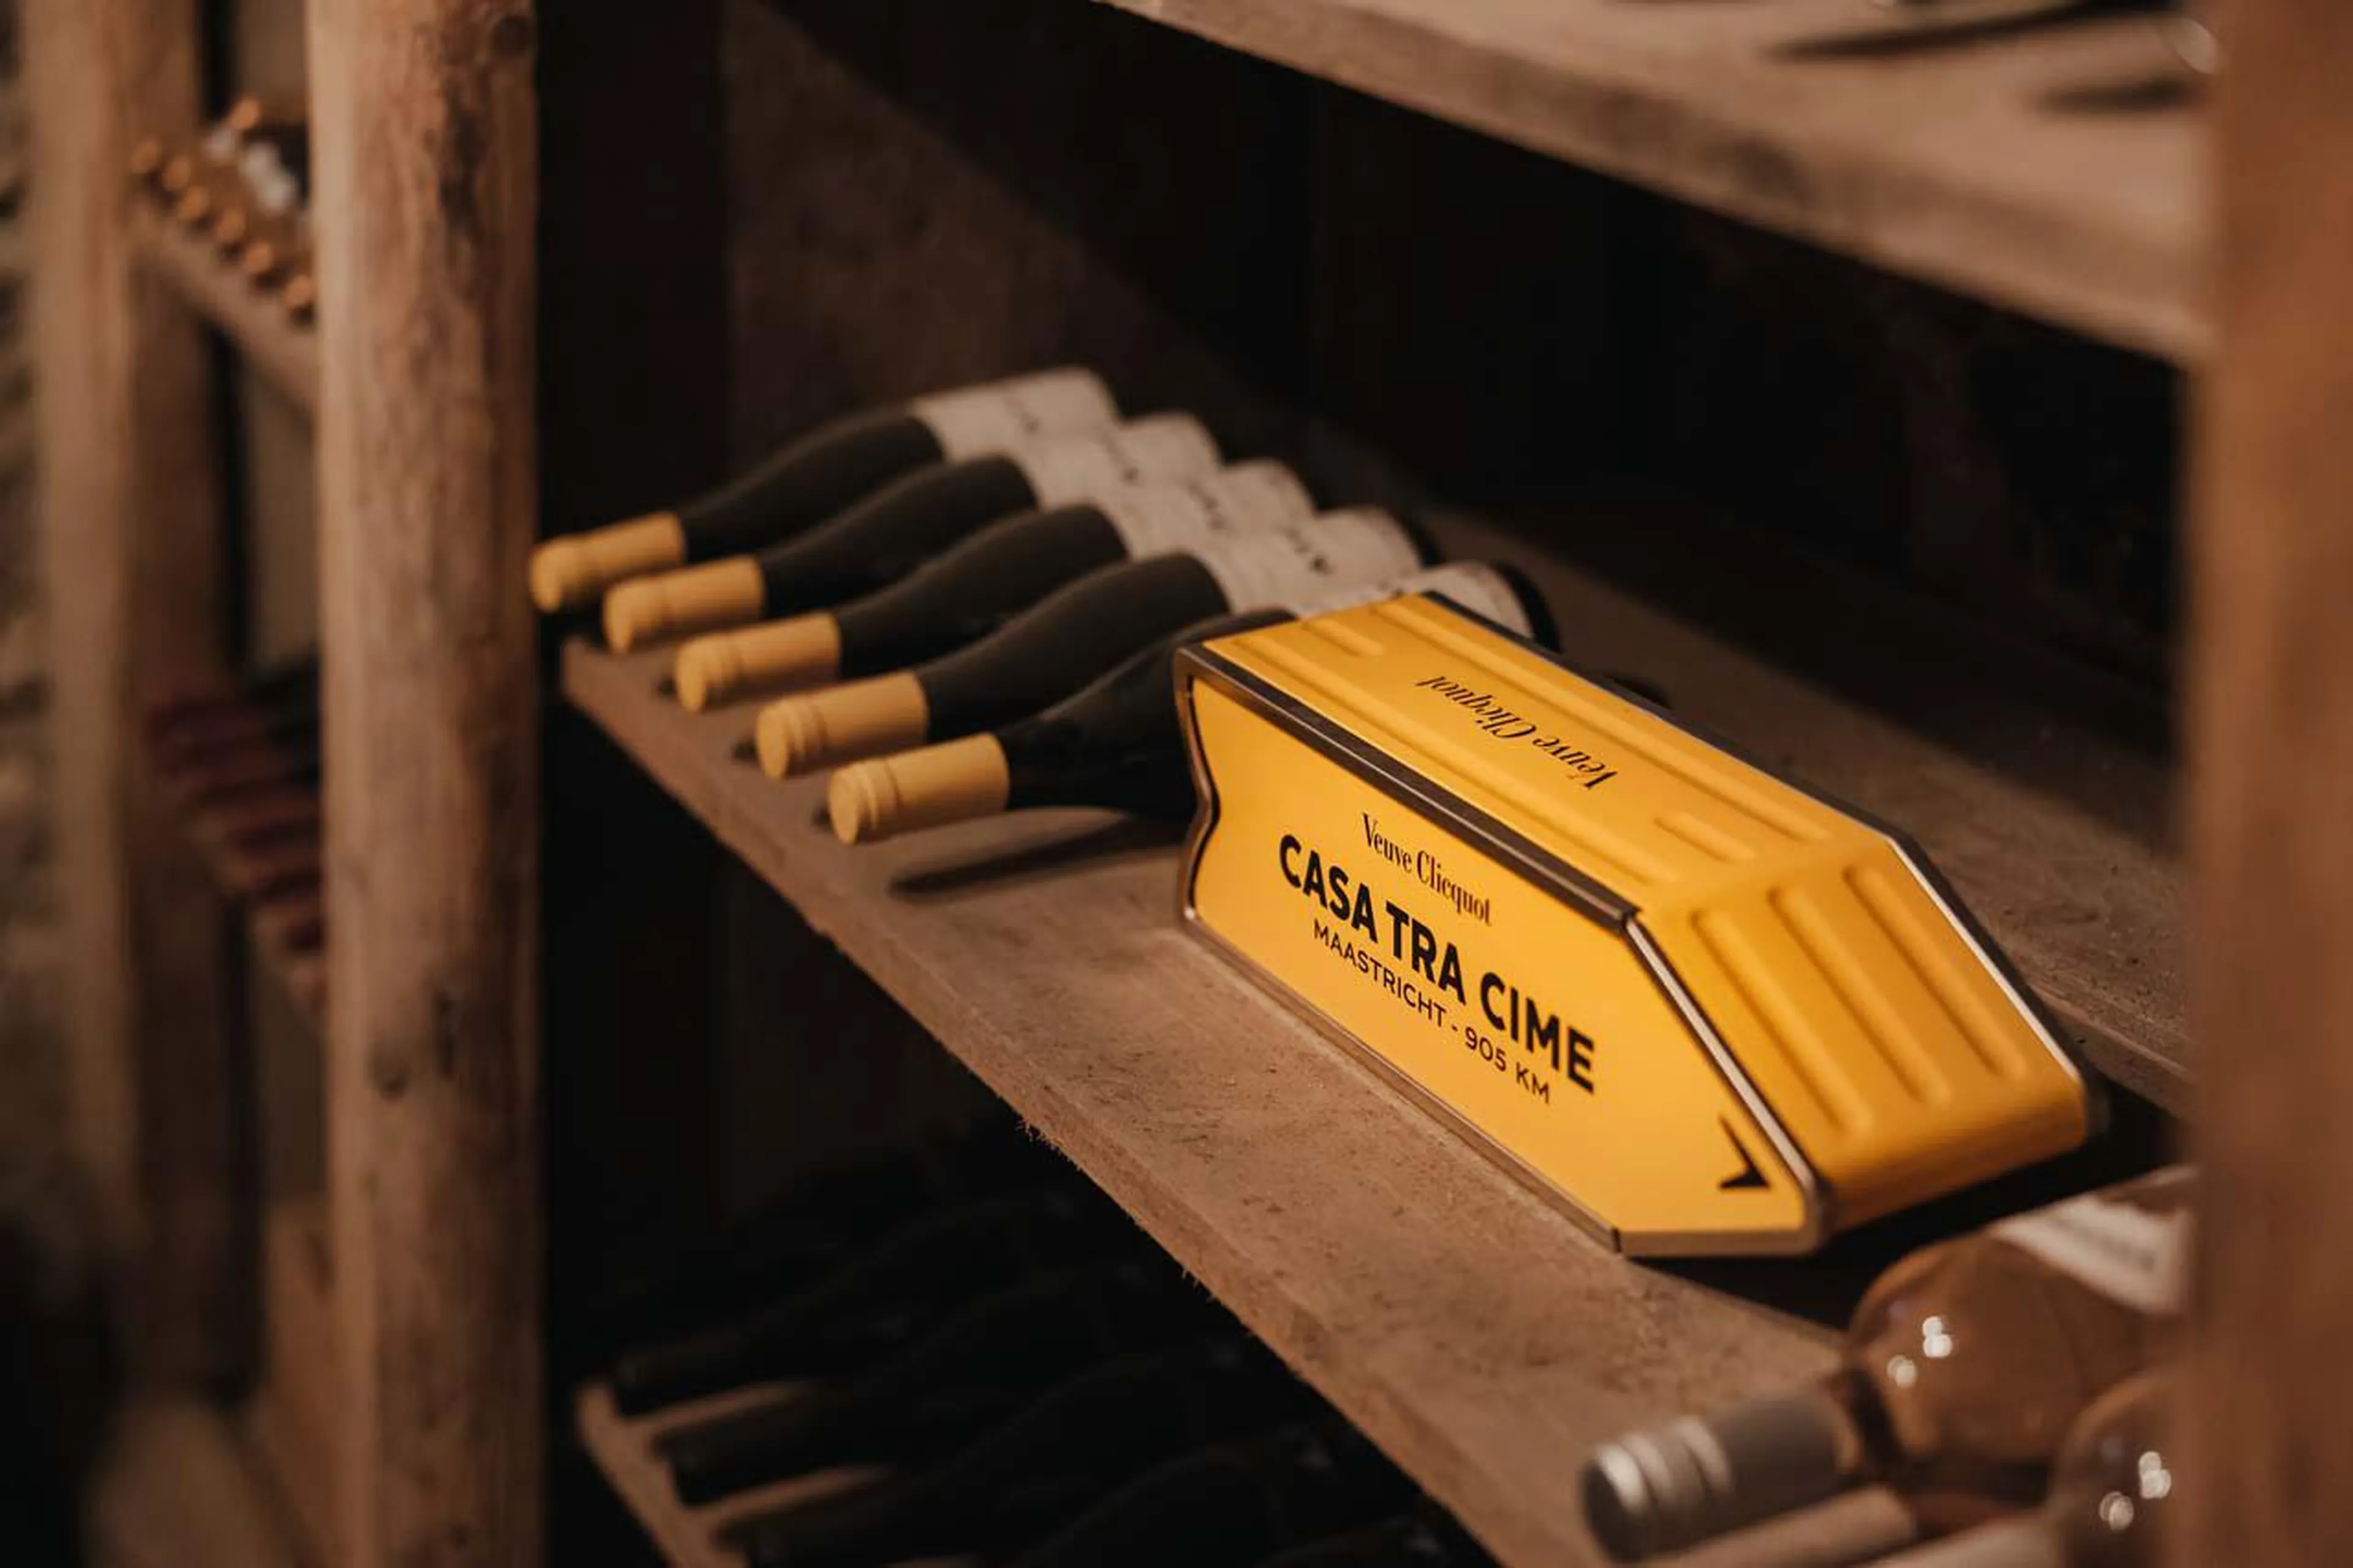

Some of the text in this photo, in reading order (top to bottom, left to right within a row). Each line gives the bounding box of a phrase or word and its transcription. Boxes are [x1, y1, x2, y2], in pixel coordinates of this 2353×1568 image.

[1414, 675, 1619, 790] Veuve Clicquot
[1362, 812, 1493, 927] Veuve Clicquot
[1279, 833, 1594, 1095] CASA TRA CIME
[1313, 918, 1447, 1029] MAASTRICHT
[1465, 1026, 1507, 1072] 905
[1515, 1061, 1550, 1105] KM
